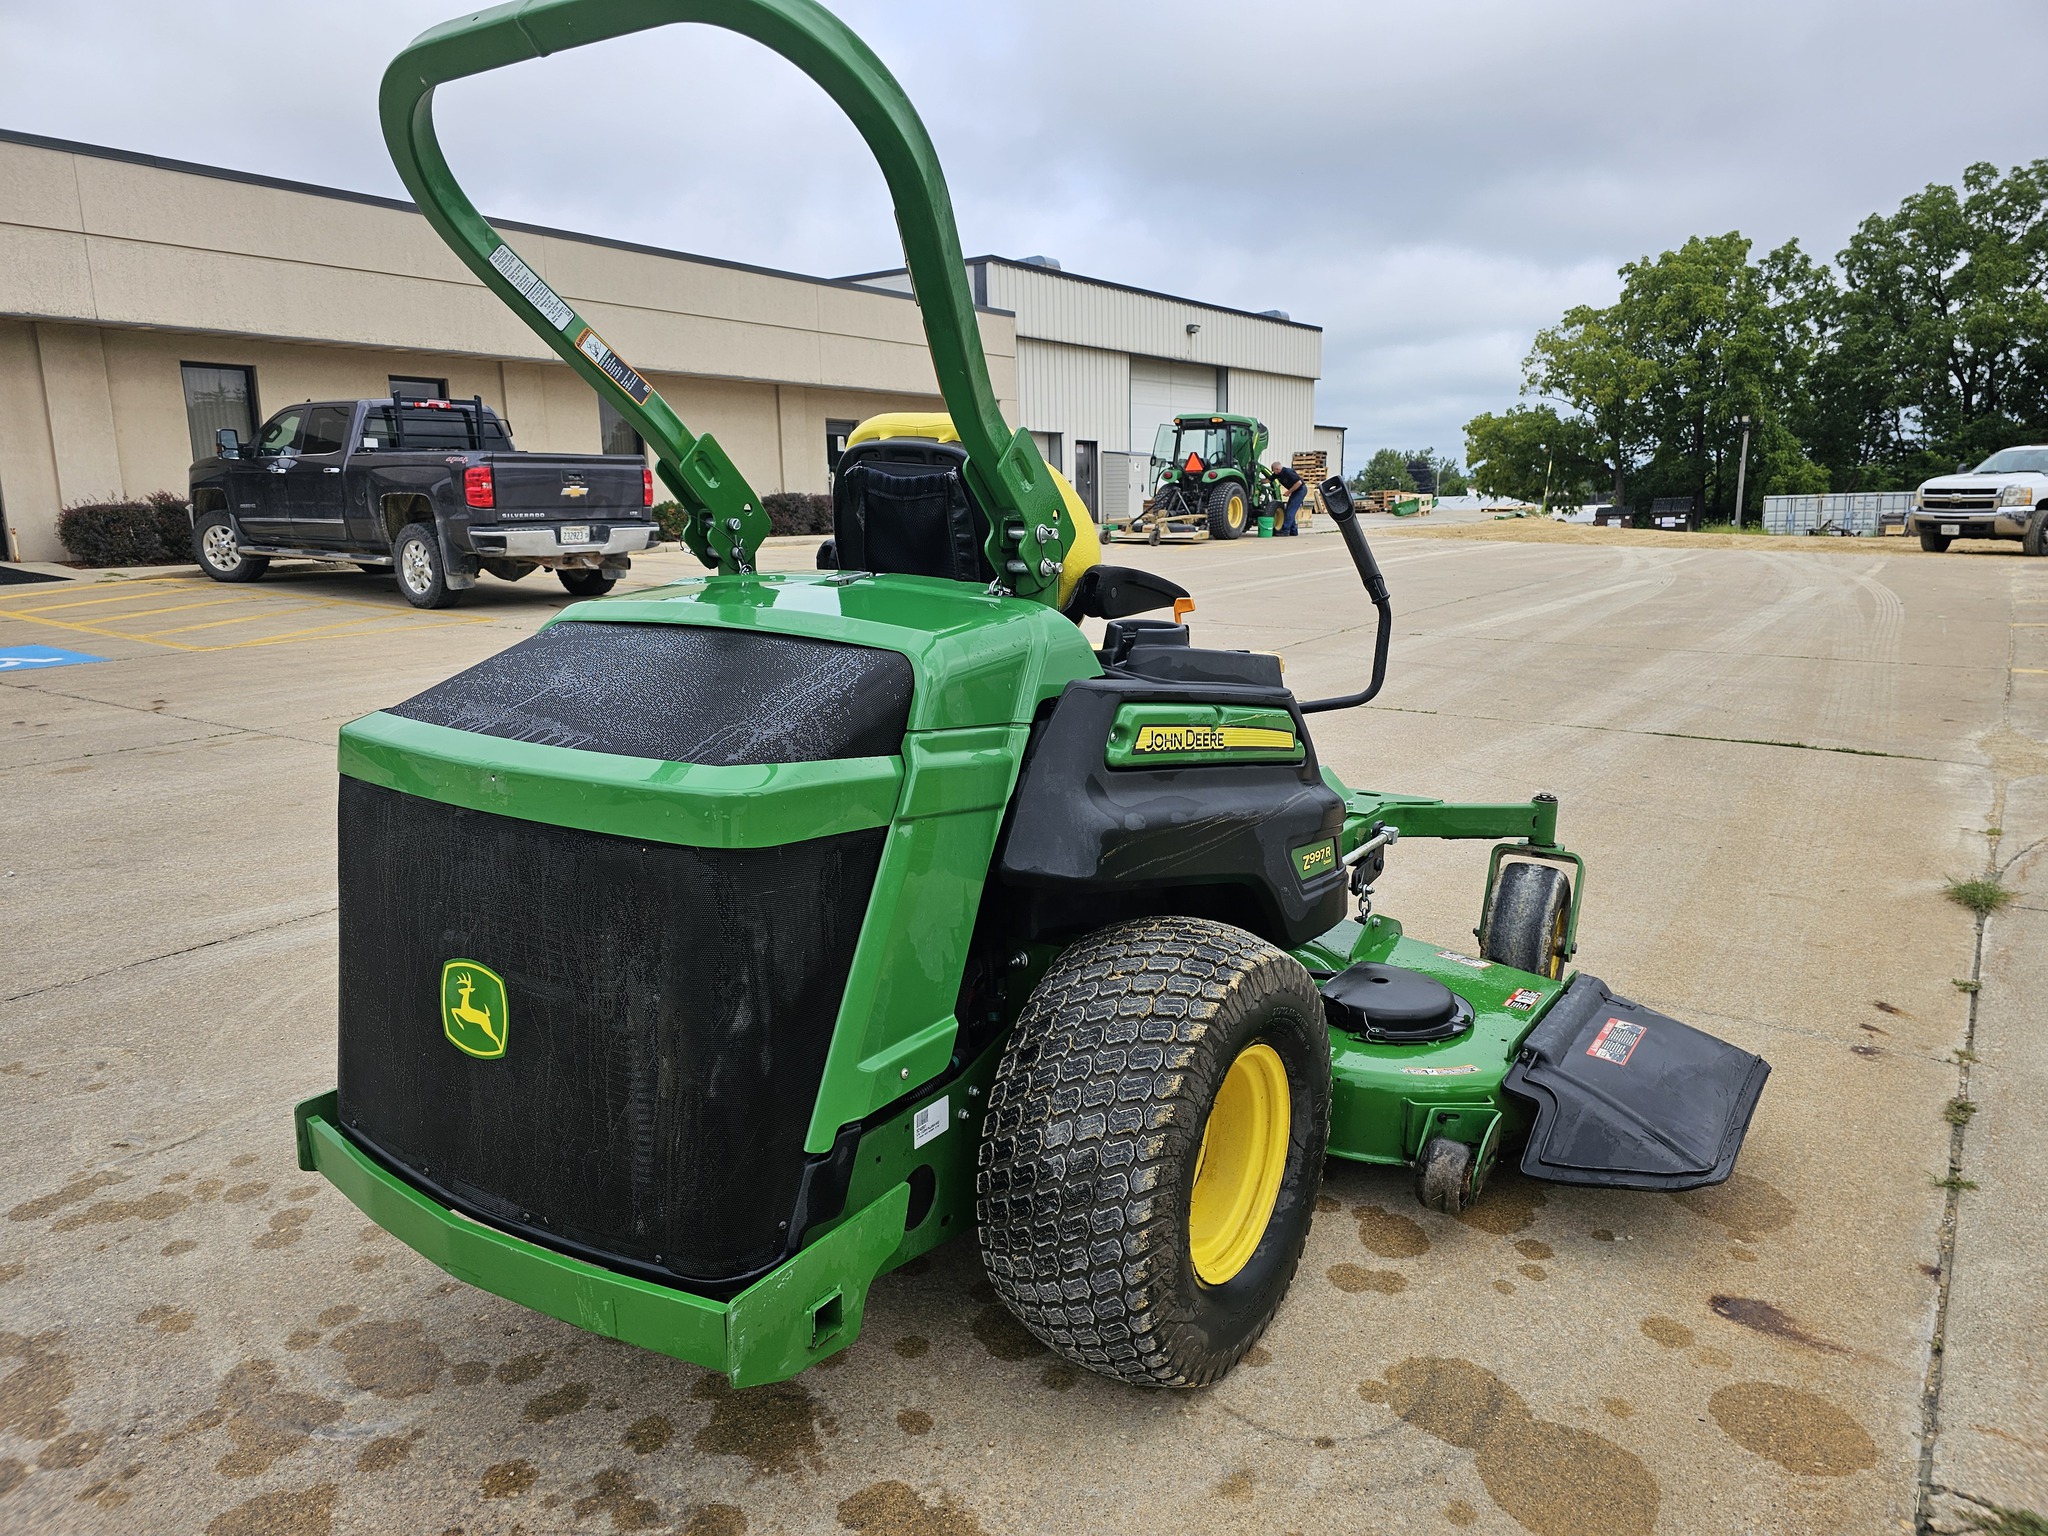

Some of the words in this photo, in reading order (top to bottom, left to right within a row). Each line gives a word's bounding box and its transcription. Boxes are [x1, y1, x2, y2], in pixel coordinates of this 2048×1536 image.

[1145, 730, 1183, 749] JOHN
[1185, 729, 1225, 748] DEERE
[1301, 846, 1332, 872] Z997R
